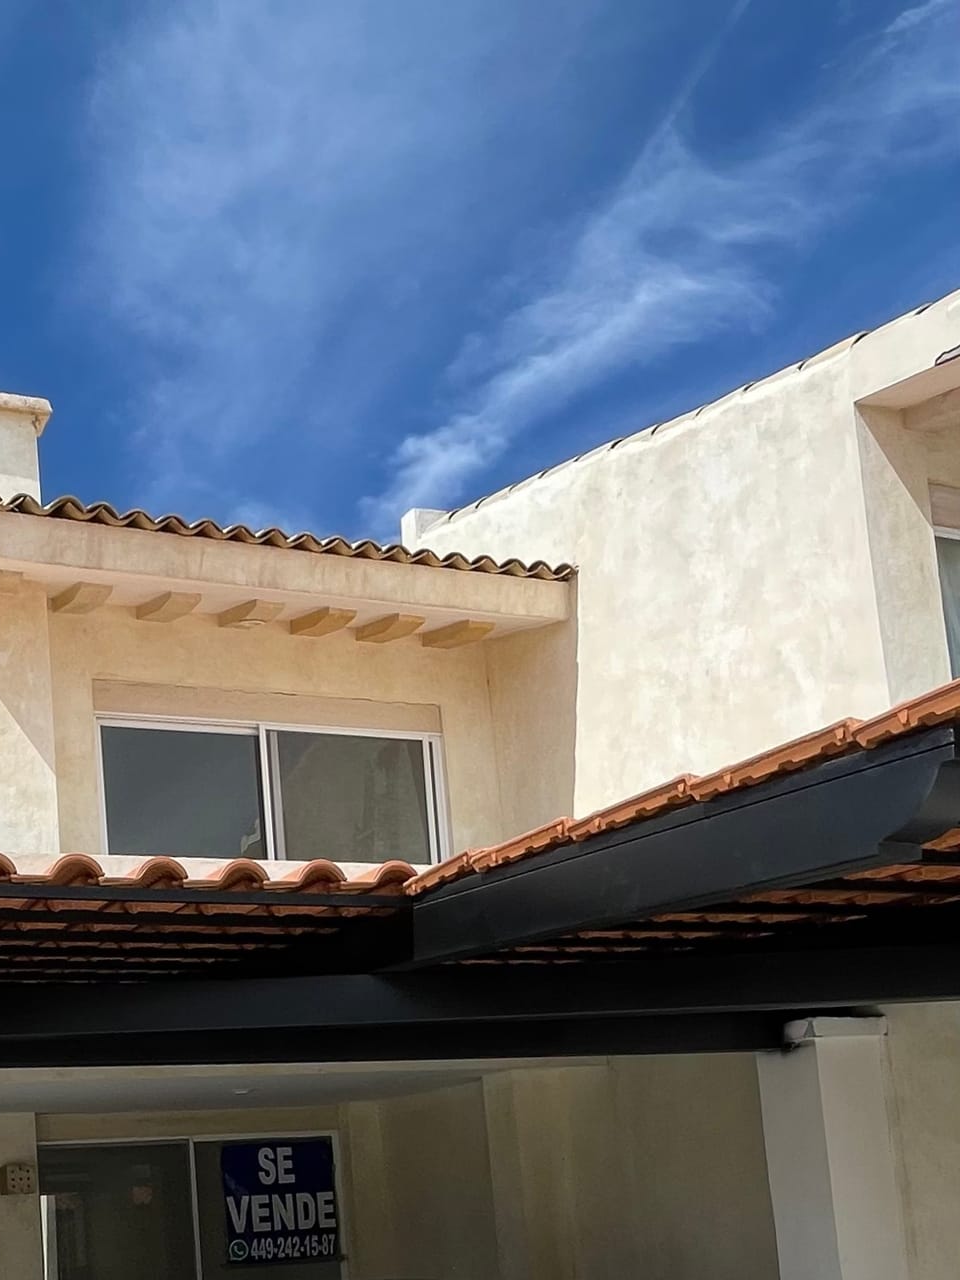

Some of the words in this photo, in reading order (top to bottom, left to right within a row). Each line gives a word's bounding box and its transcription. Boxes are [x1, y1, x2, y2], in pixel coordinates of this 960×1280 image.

[258, 1147, 295, 1185] SE
[226, 1191, 336, 1233] VENDE
[250, 1234, 336, 1260] 449-242-15-87
